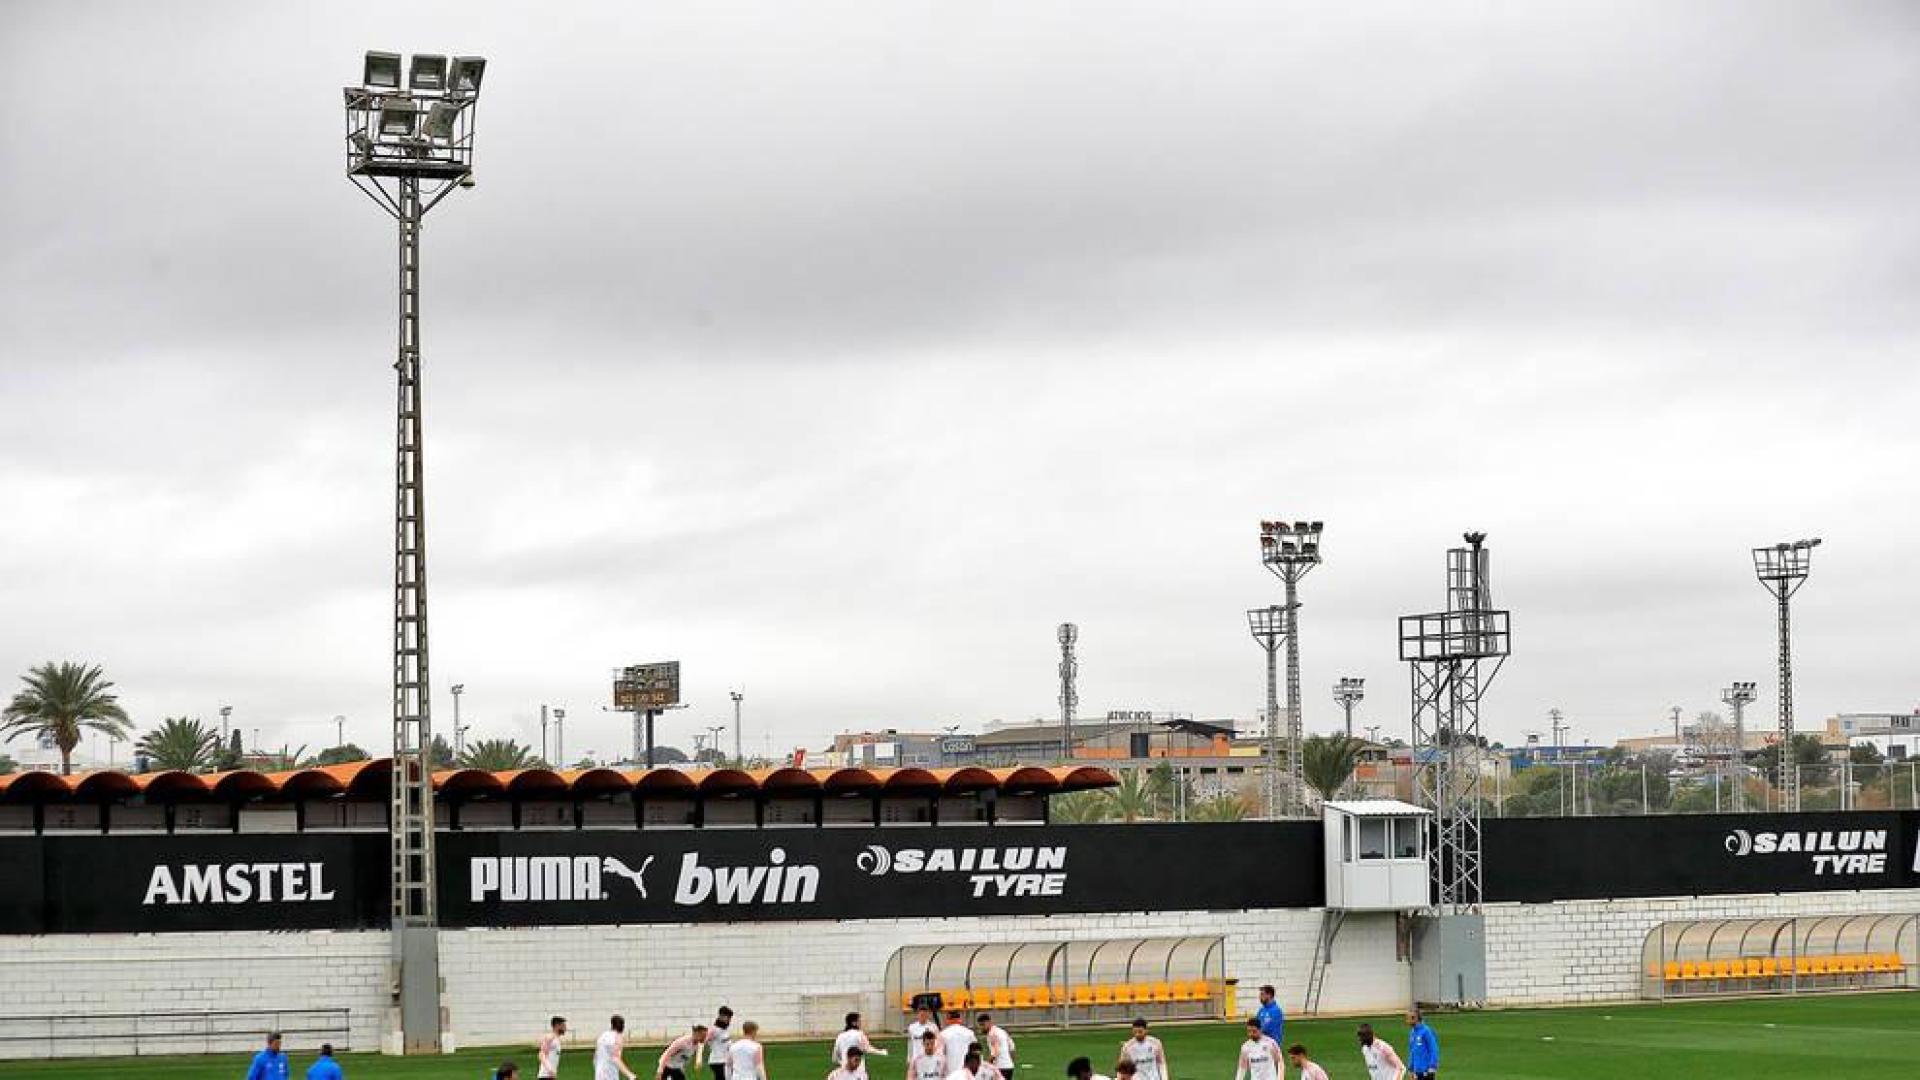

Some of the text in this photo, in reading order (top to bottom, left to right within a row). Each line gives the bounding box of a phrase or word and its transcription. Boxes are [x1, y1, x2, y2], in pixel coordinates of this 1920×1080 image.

[1753, 829, 1888, 854] SAILUN
[893, 846, 1068, 873] SAILUN
[1812, 853, 1888, 875] TYRE
[143, 862, 335, 905] AMSTEL
[470, 856, 602, 902] PUMA
[674, 847, 820, 905] bwin
[969, 873, 1068, 897] TYRE
